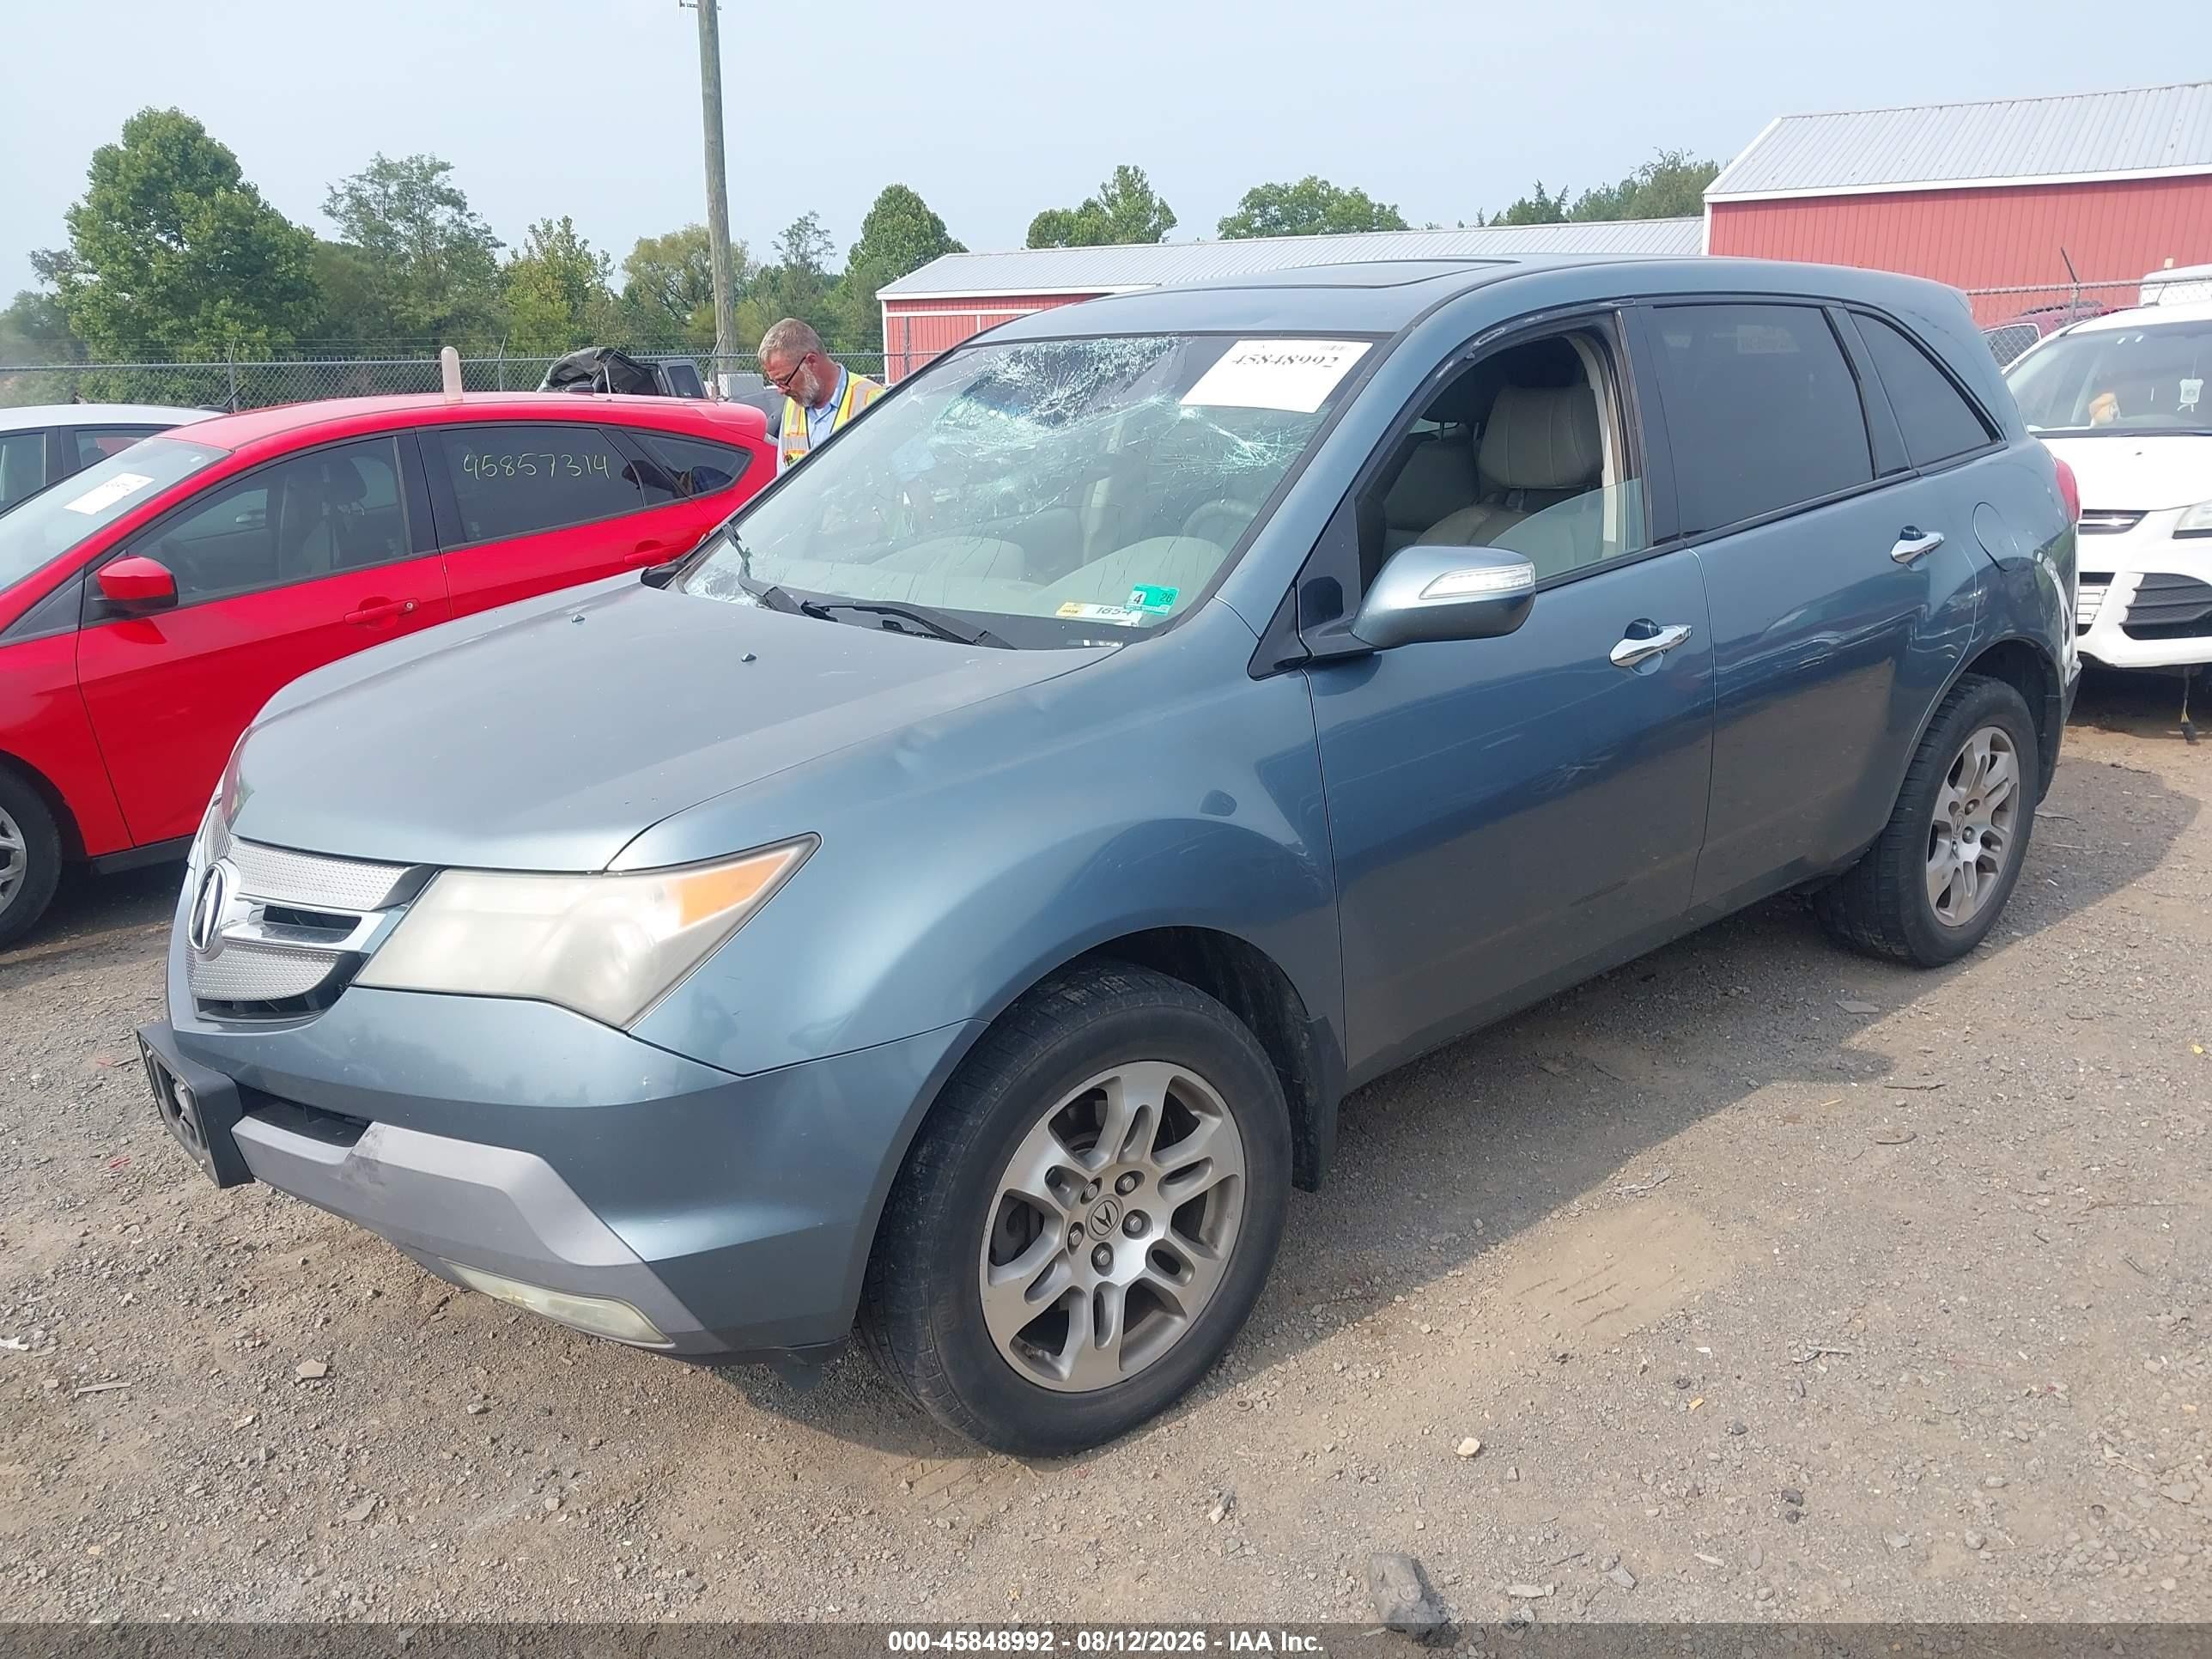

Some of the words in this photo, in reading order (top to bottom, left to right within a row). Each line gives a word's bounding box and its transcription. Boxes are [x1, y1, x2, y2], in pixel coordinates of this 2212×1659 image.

[462, 453, 611, 480] 45857314
[1133, 593, 1143, 605] 4
[1160, 592, 1175, 603] 26
